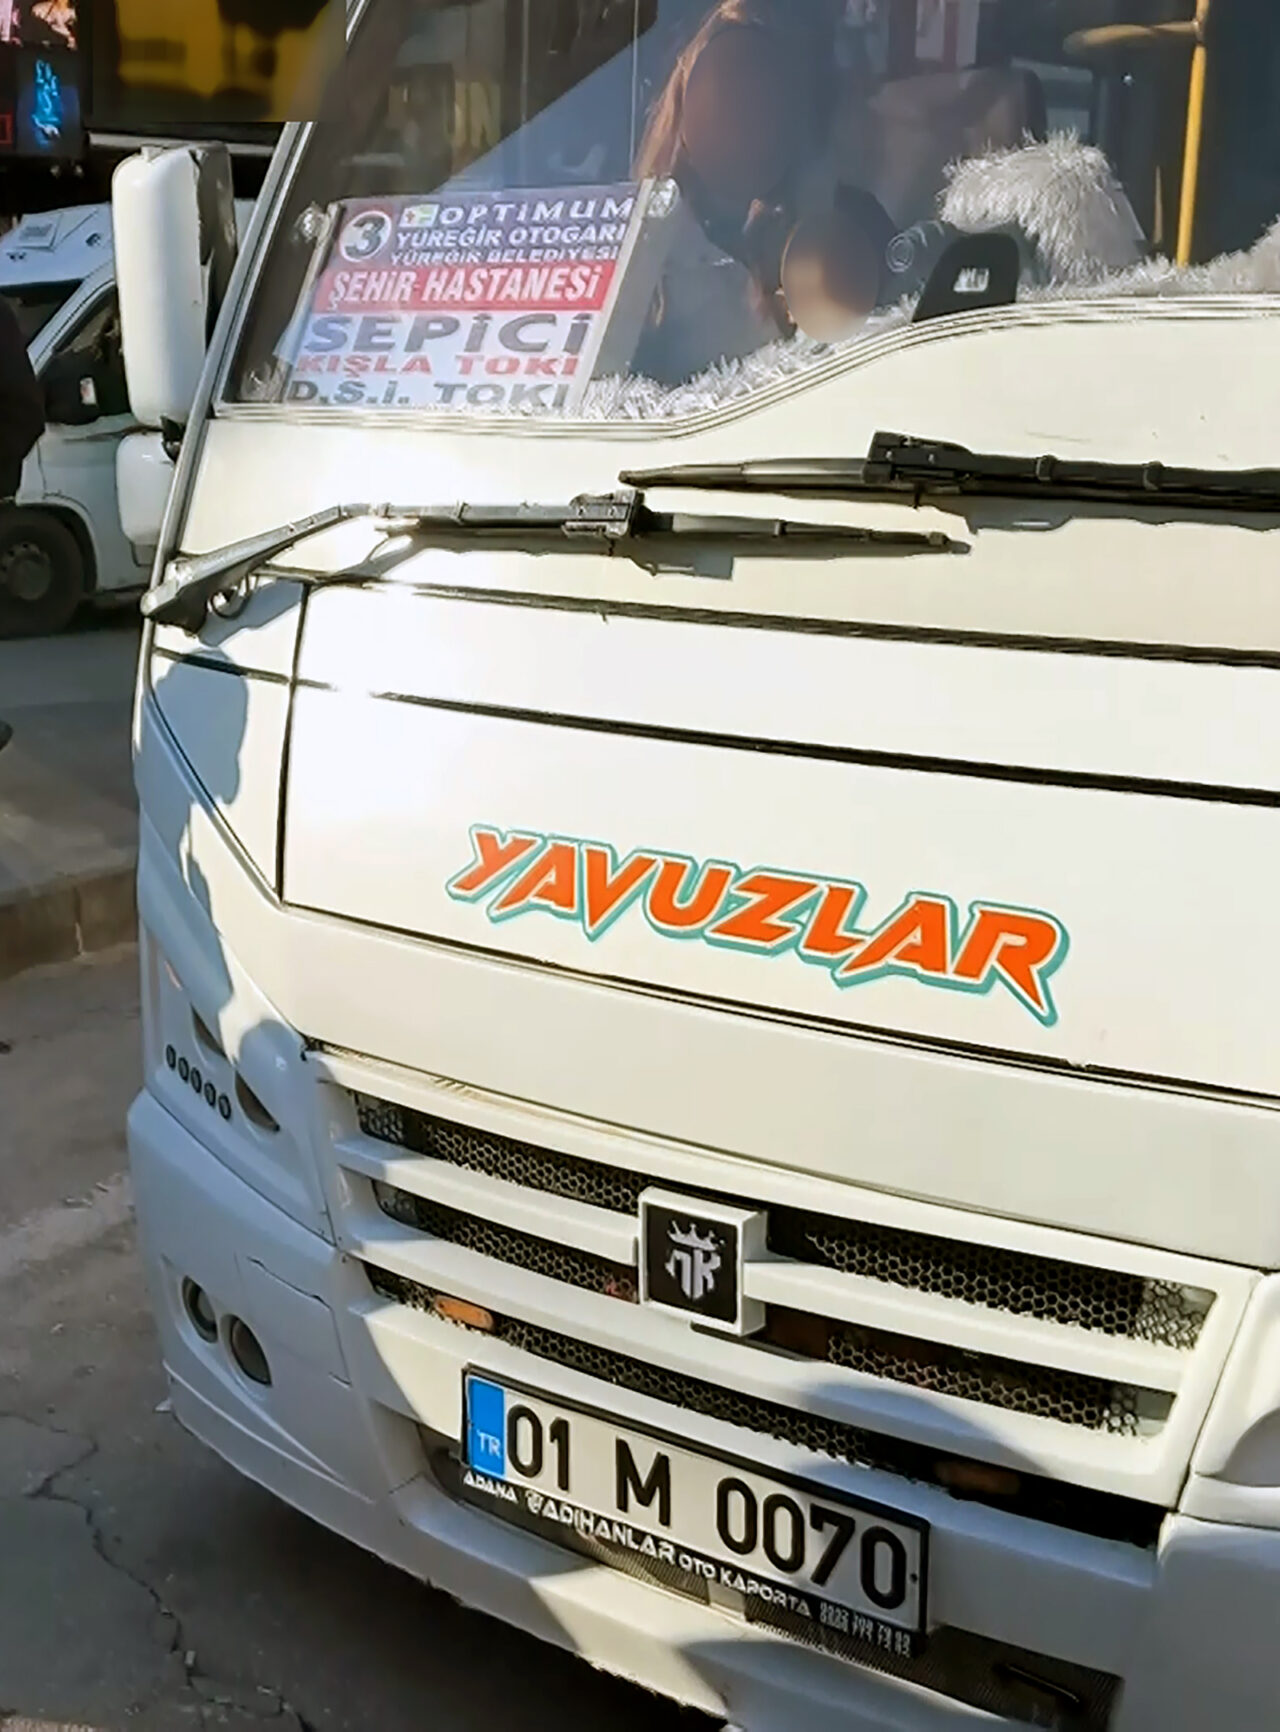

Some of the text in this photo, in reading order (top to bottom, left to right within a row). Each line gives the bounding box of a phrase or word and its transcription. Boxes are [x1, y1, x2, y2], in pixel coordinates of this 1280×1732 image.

[344, 219, 385, 257] 3
[445, 823, 1071, 1027] YAVUZLAR
[506, 1403, 907, 1610] 01 M 0070
